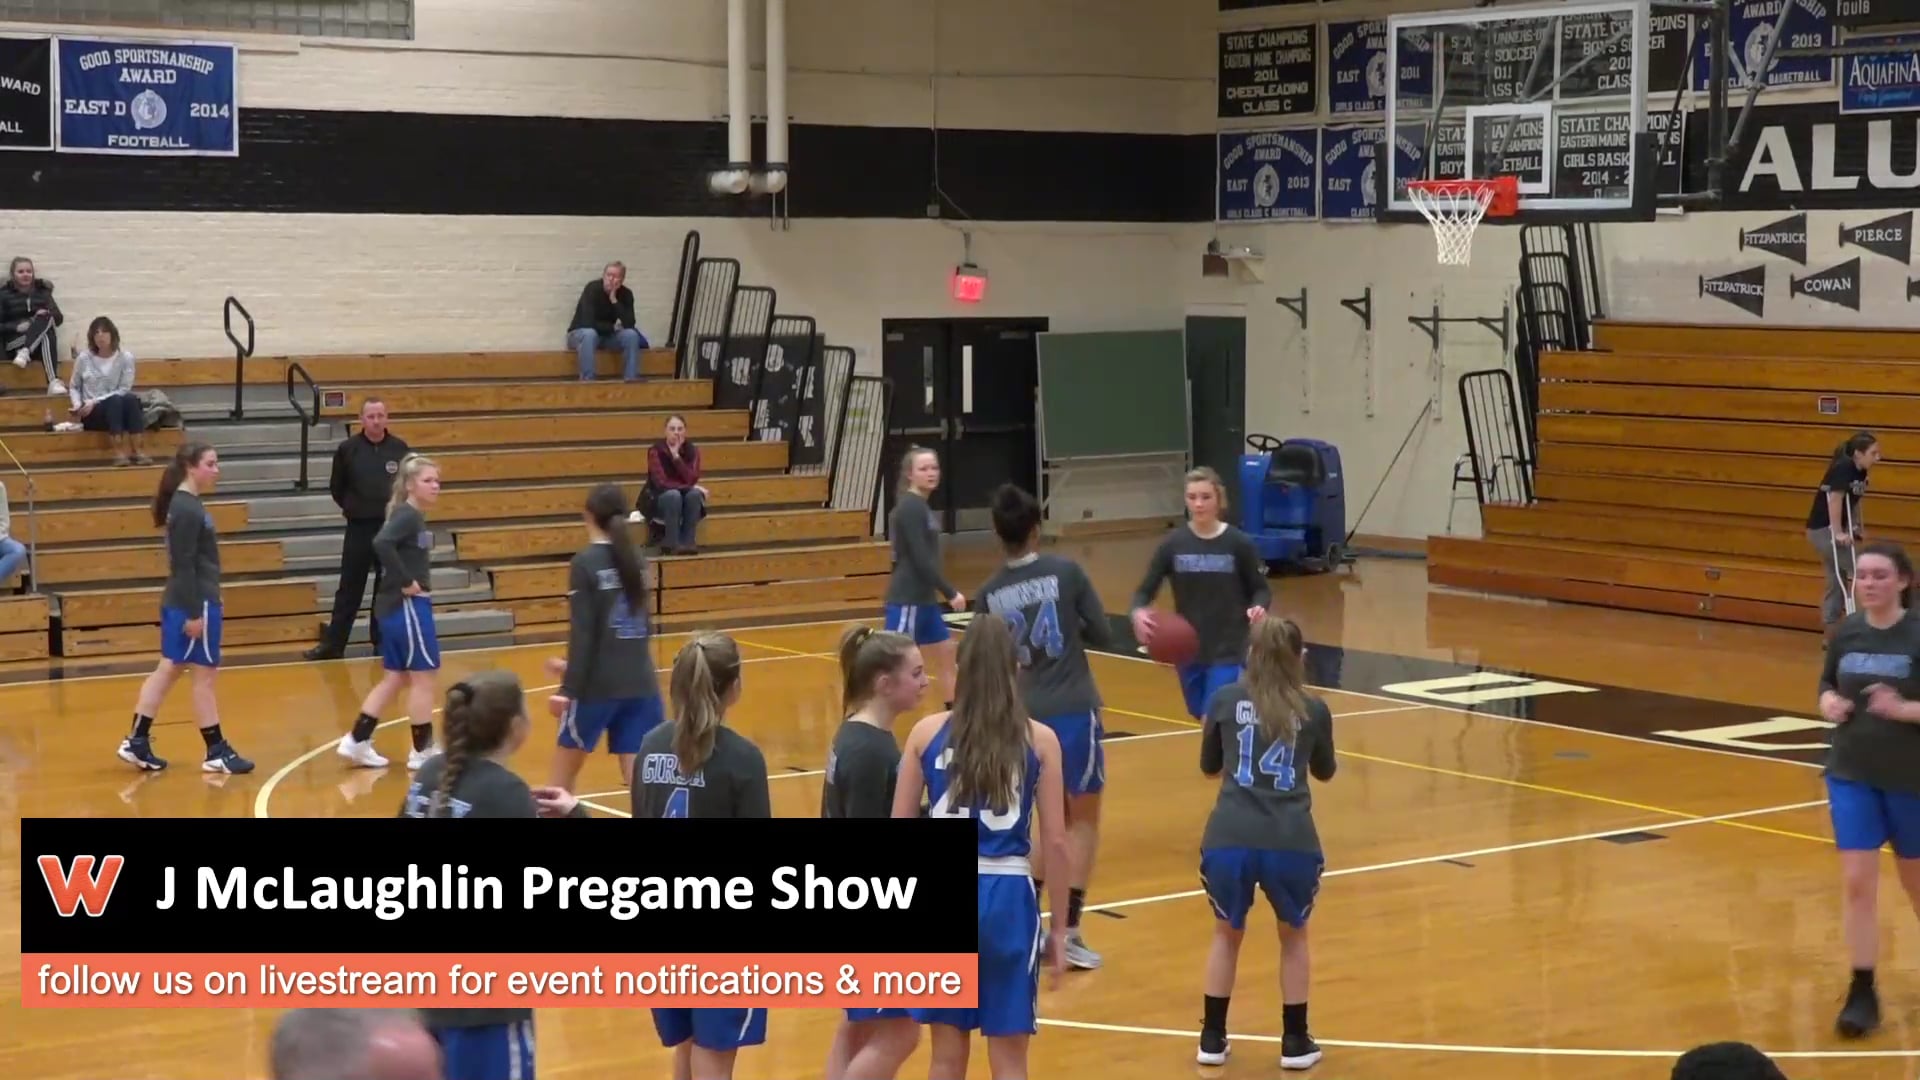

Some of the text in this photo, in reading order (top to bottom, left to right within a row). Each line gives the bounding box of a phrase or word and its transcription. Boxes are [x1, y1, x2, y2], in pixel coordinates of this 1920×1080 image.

[1564, 22, 1609, 40] STATE
[1226, 30, 1309, 50] STATE CHAMPIONS
[1332, 32, 1355, 60] GOOD
[1791, 33, 1822, 48] 2013
[79, 48, 215, 75] GOOD SPORTSMANSHIP
[1609, 57, 1632, 71] 201
[119, 67, 177, 84] AWARD
[1254, 69, 1279, 82] 2011
[1336, 70, 1360, 84] EAST
[1400, 65, 1421, 79] 2011
[1848, 53, 1920, 90] AQUAFINA
[1226, 82, 1309, 100] CHEERLEADING
[64, 99, 126, 115] EAST D
[190, 103, 230, 118] 2014
[1242, 99, 1292, 113] CLASS C
[1560, 117, 1601, 134] STATE
[108, 134, 190, 147] FOOTBALL
[1560, 132, 1627, 148] EASTERN MAINE
[1223, 133, 1314, 170] GOOD SPORTSMANSHIP
[1253, 148, 1282, 160] AWARD
[1325, 139, 1348, 165] GOOD
[1563, 153, 1596, 168] GIRLS
[1226, 176, 1310, 192] EAST 2013
[1328, 177, 1352, 191] EAST
[1582, 171, 1610, 186] 2014
[1743, 232, 1806, 245] FITZPATRICK
[1854, 228, 1903, 242] PIERCE
[1702, 279, 1764, 296] FITZPATRICK
[1803, 277, 1852, 293] COWAN
[1233, 724, 1295, 791] 14
